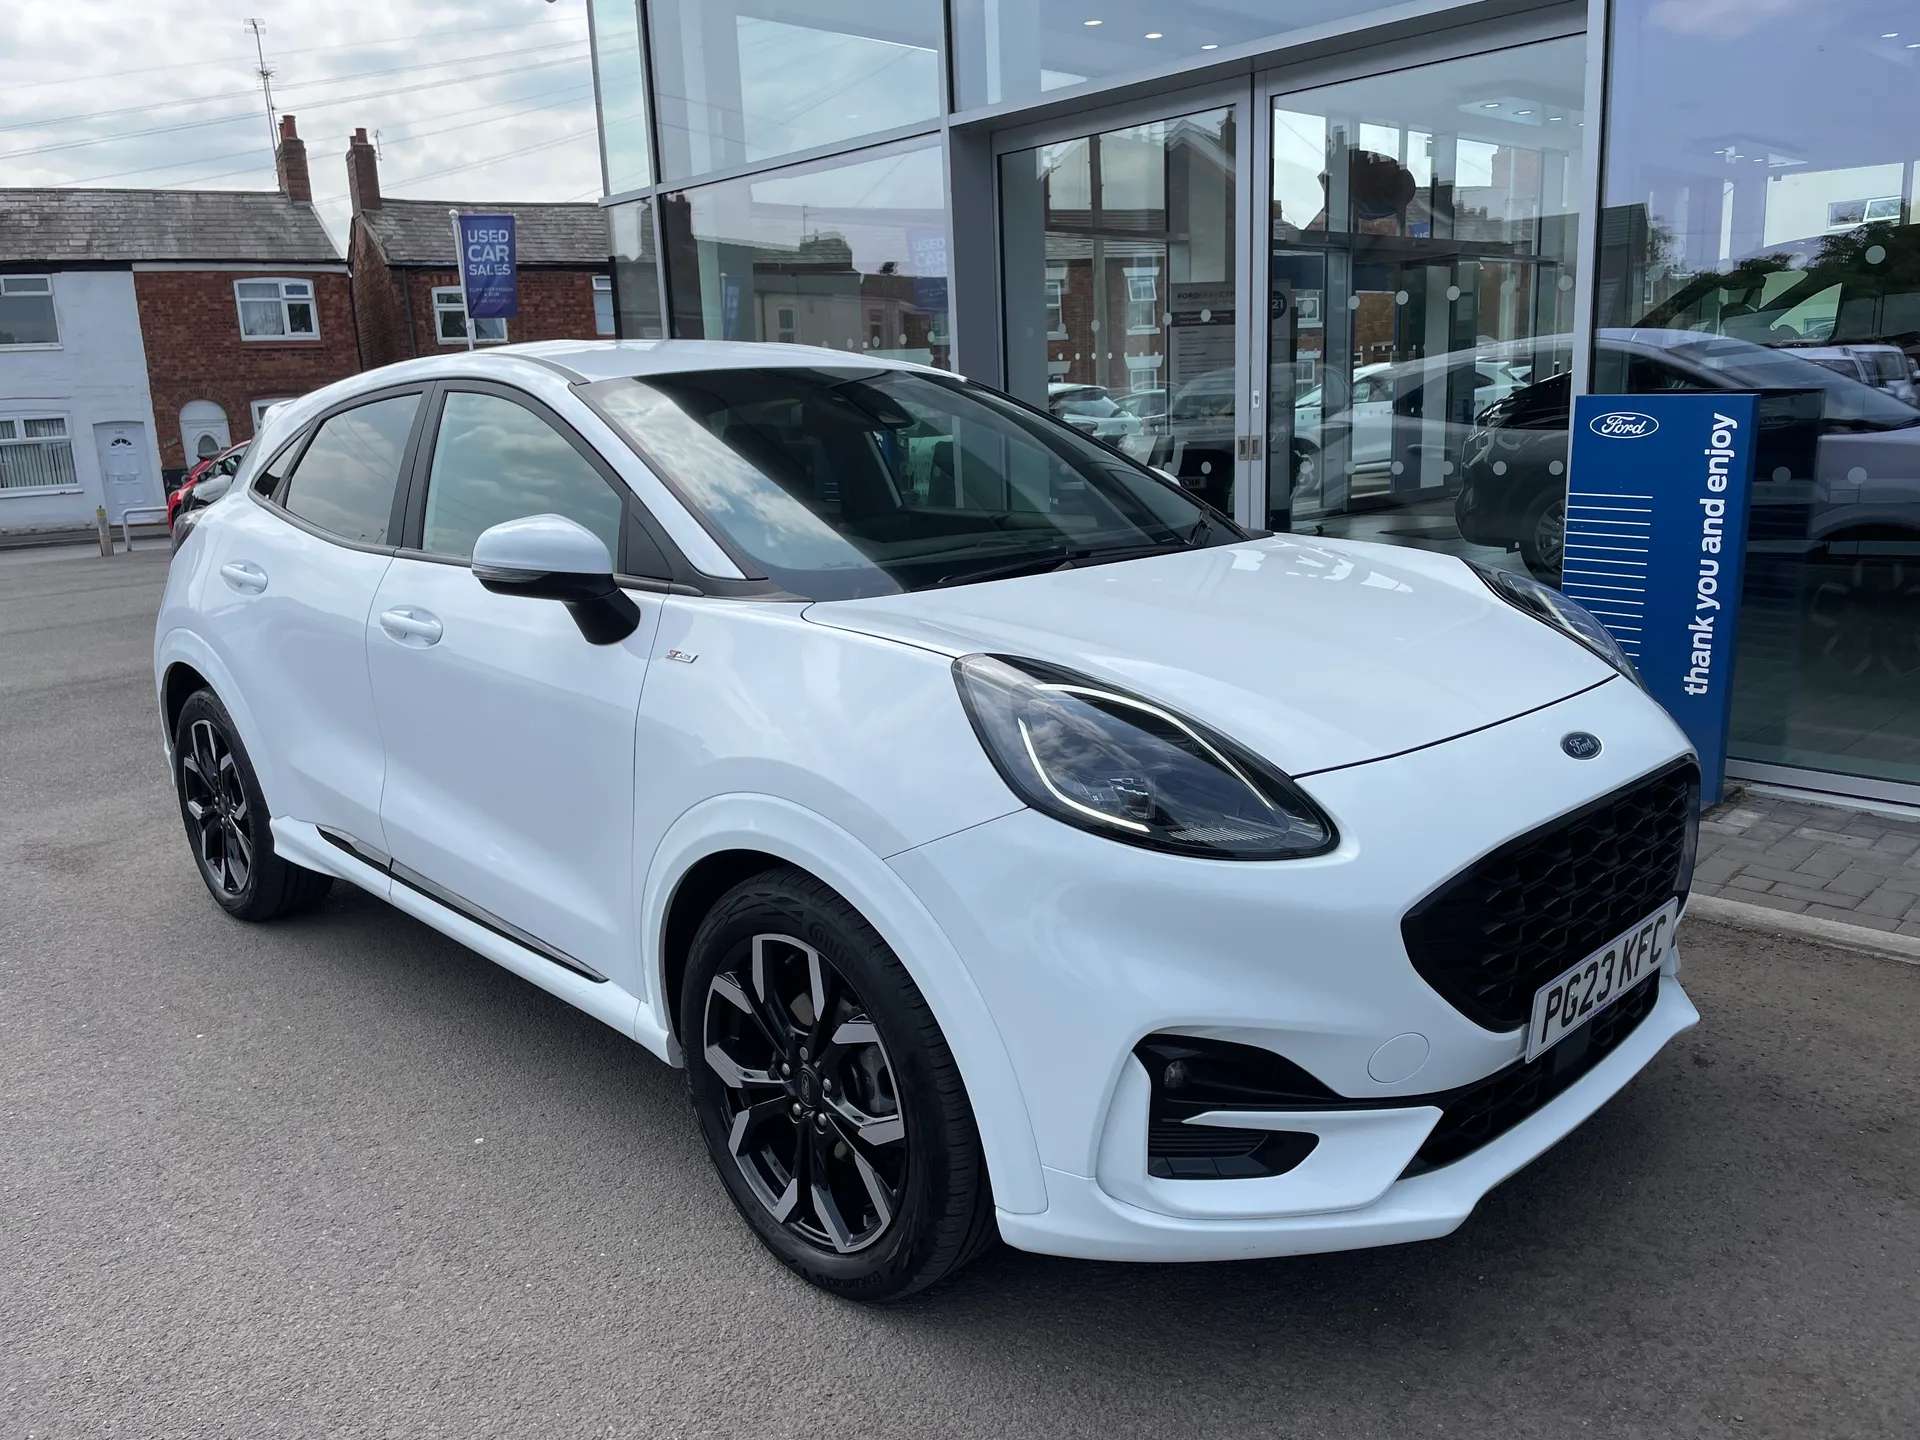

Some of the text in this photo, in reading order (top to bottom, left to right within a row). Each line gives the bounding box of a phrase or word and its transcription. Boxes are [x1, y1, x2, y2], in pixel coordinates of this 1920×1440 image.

[467, 229, 509, 243] USED
[467, 245, 510, 263] CAR
[469, 263, 512, 276] SALES
[1601, 415, 1647, 434] Ford
[1684, 412, 1738, 696] thank you and enjoy
[1541, 914, 1667, 1044] PG23 KFC
